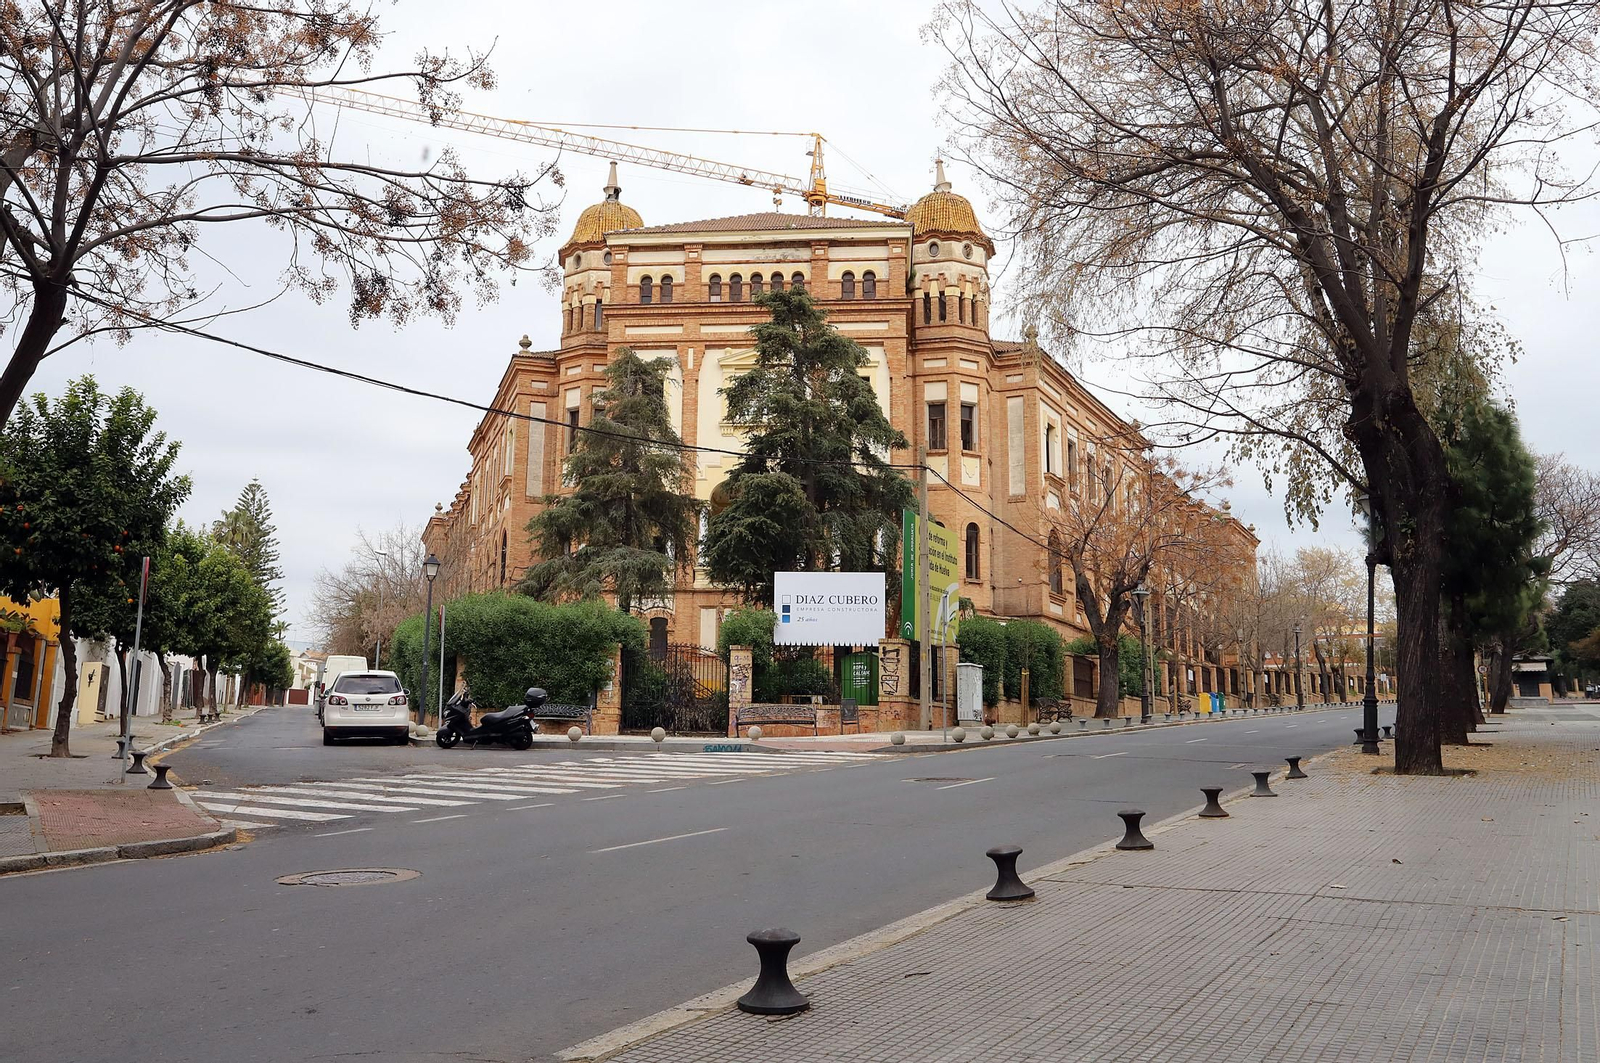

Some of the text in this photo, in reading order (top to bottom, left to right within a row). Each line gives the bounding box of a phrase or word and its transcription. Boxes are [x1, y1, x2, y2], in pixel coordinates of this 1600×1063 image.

[933, 533, 946, 547] reforma
[796, 594, 878, 605] DIAZ CUBERO
